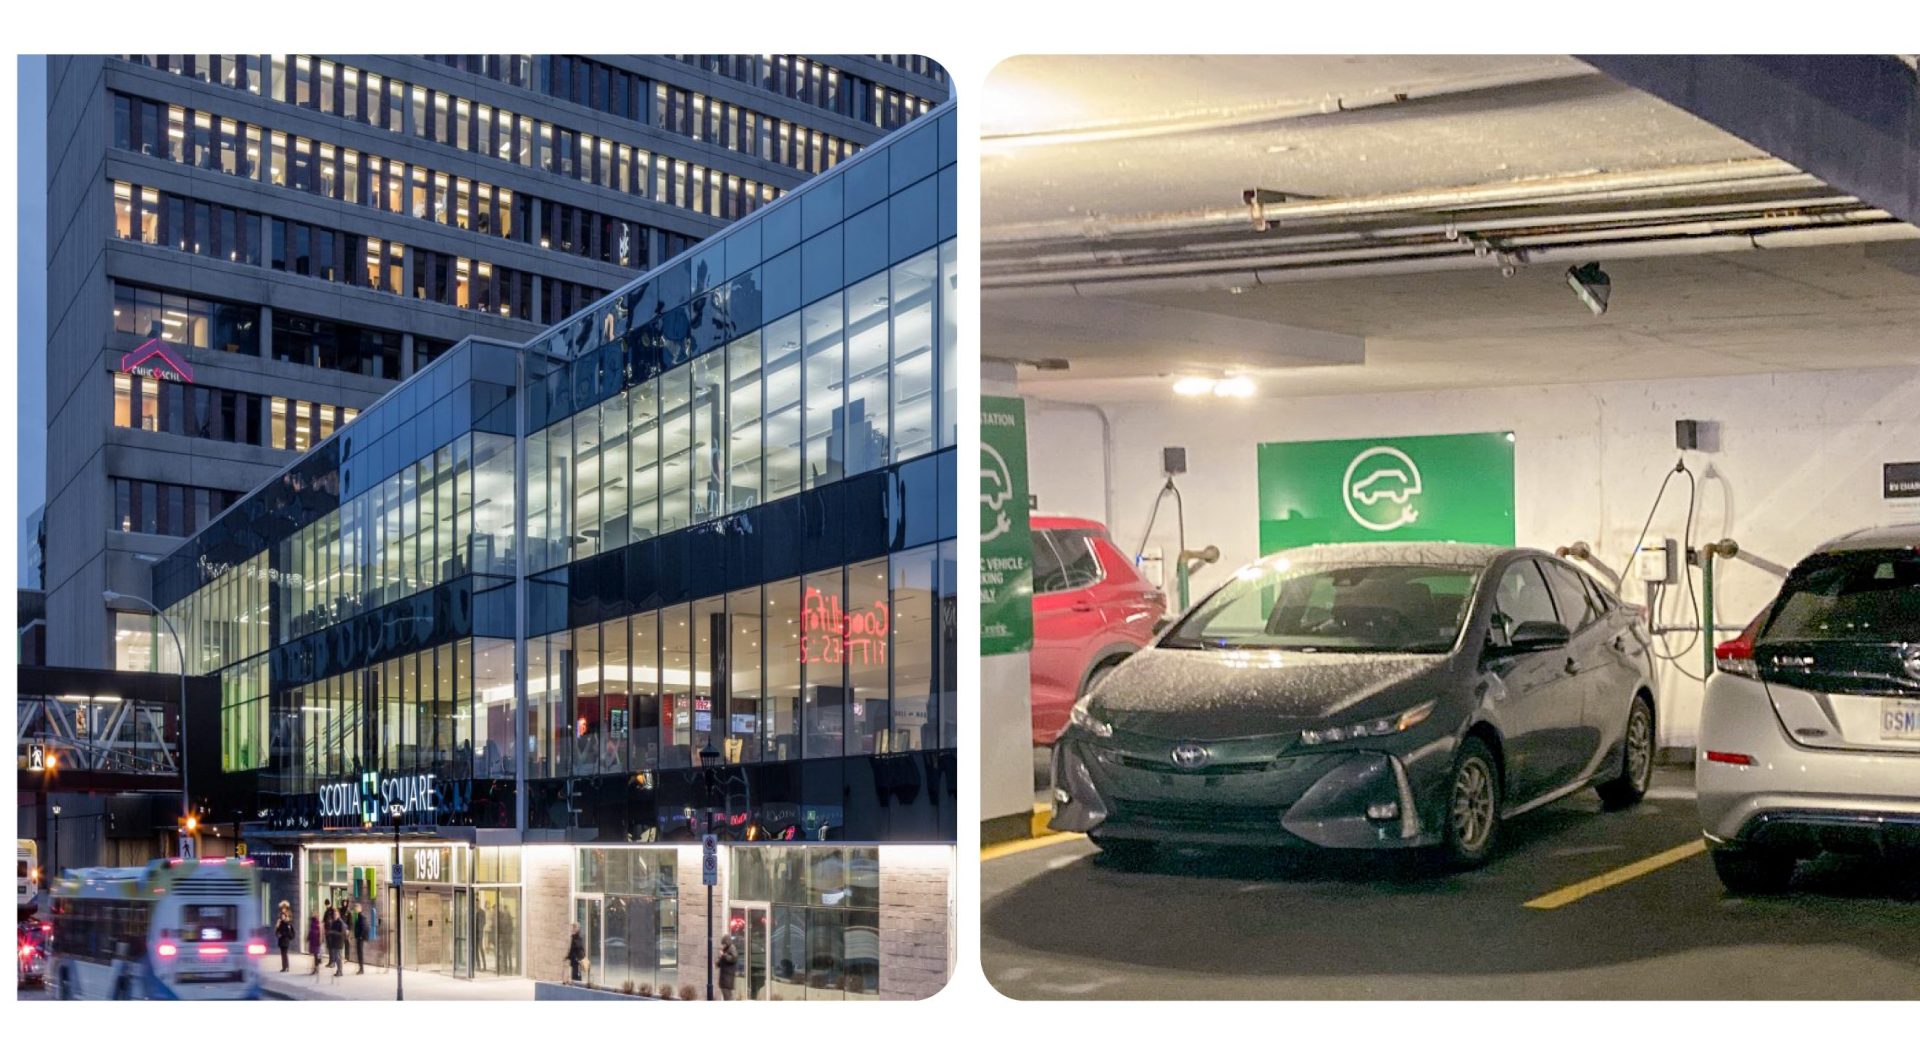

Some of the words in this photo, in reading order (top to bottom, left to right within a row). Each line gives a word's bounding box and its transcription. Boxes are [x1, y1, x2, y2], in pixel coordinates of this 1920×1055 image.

[980, 412, 1015, 427] TATION
[987, 556, 1024, 570] VEHICLE
[319, 783, 362, 816] SCOTIA
[381, 774, 437, 814] SQUARE
[414, 848, 440, 880] 1930
